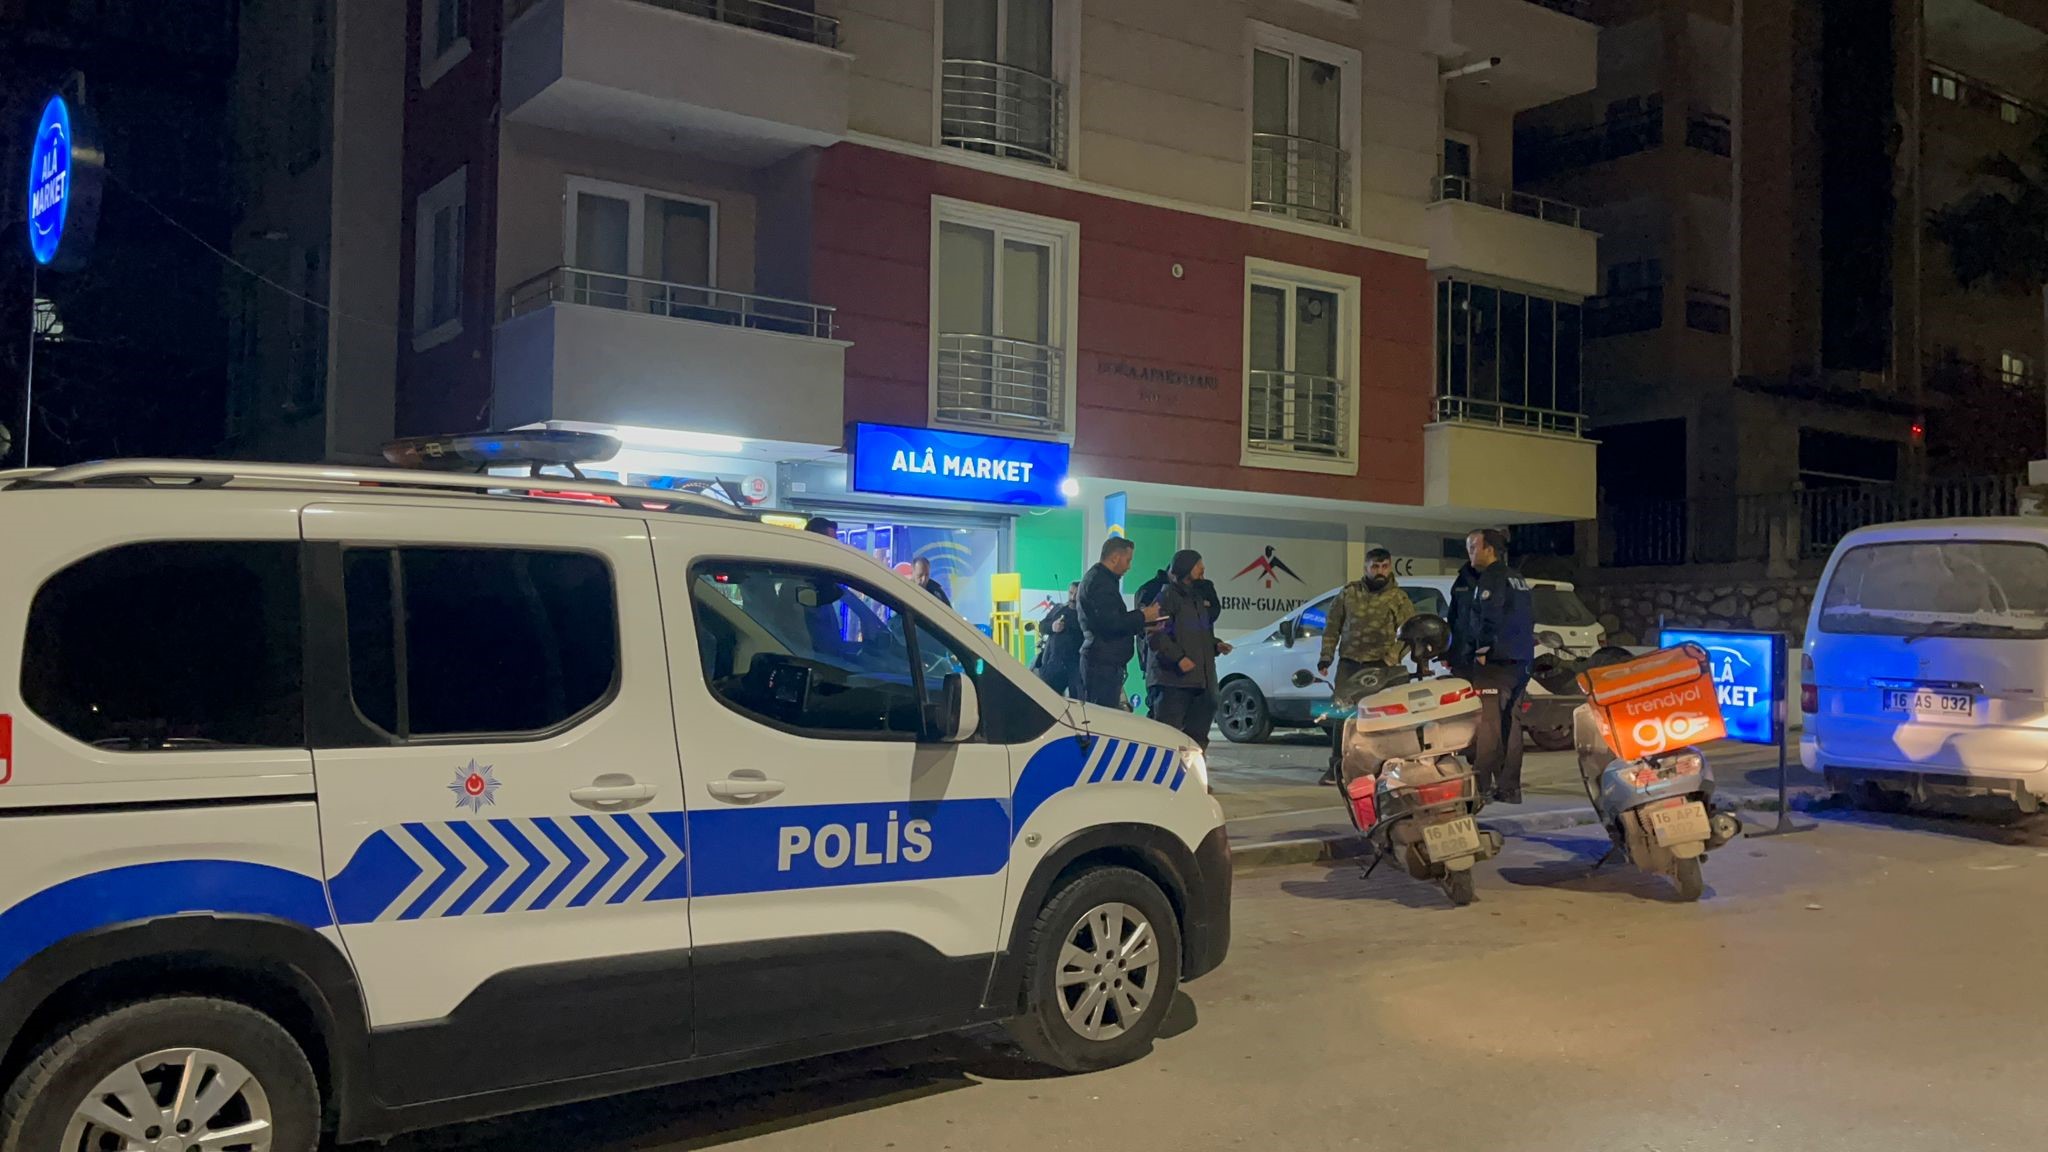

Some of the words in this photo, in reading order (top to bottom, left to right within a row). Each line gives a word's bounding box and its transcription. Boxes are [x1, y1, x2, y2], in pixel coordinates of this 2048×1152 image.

[32, 170, 66, 219] MARKET
[891, 446, 937, 474] ALÂ
[943, 454, 1033, 483] MARKET
[1709, 655, 1735, 683] LÂ
[1626, 687, 1701, 717] trendyol
[1893, 692, 1908, 707] 16
[1914, 695, 1932, 709] AS
[1940, 696, 1967, 711] 032
[1632, 711, 1706, 757] go
[1655, 812, 1671, 824] 16
[777, 810, 933, 872] POLİS
[1426, 827, 1442, 840] 16
